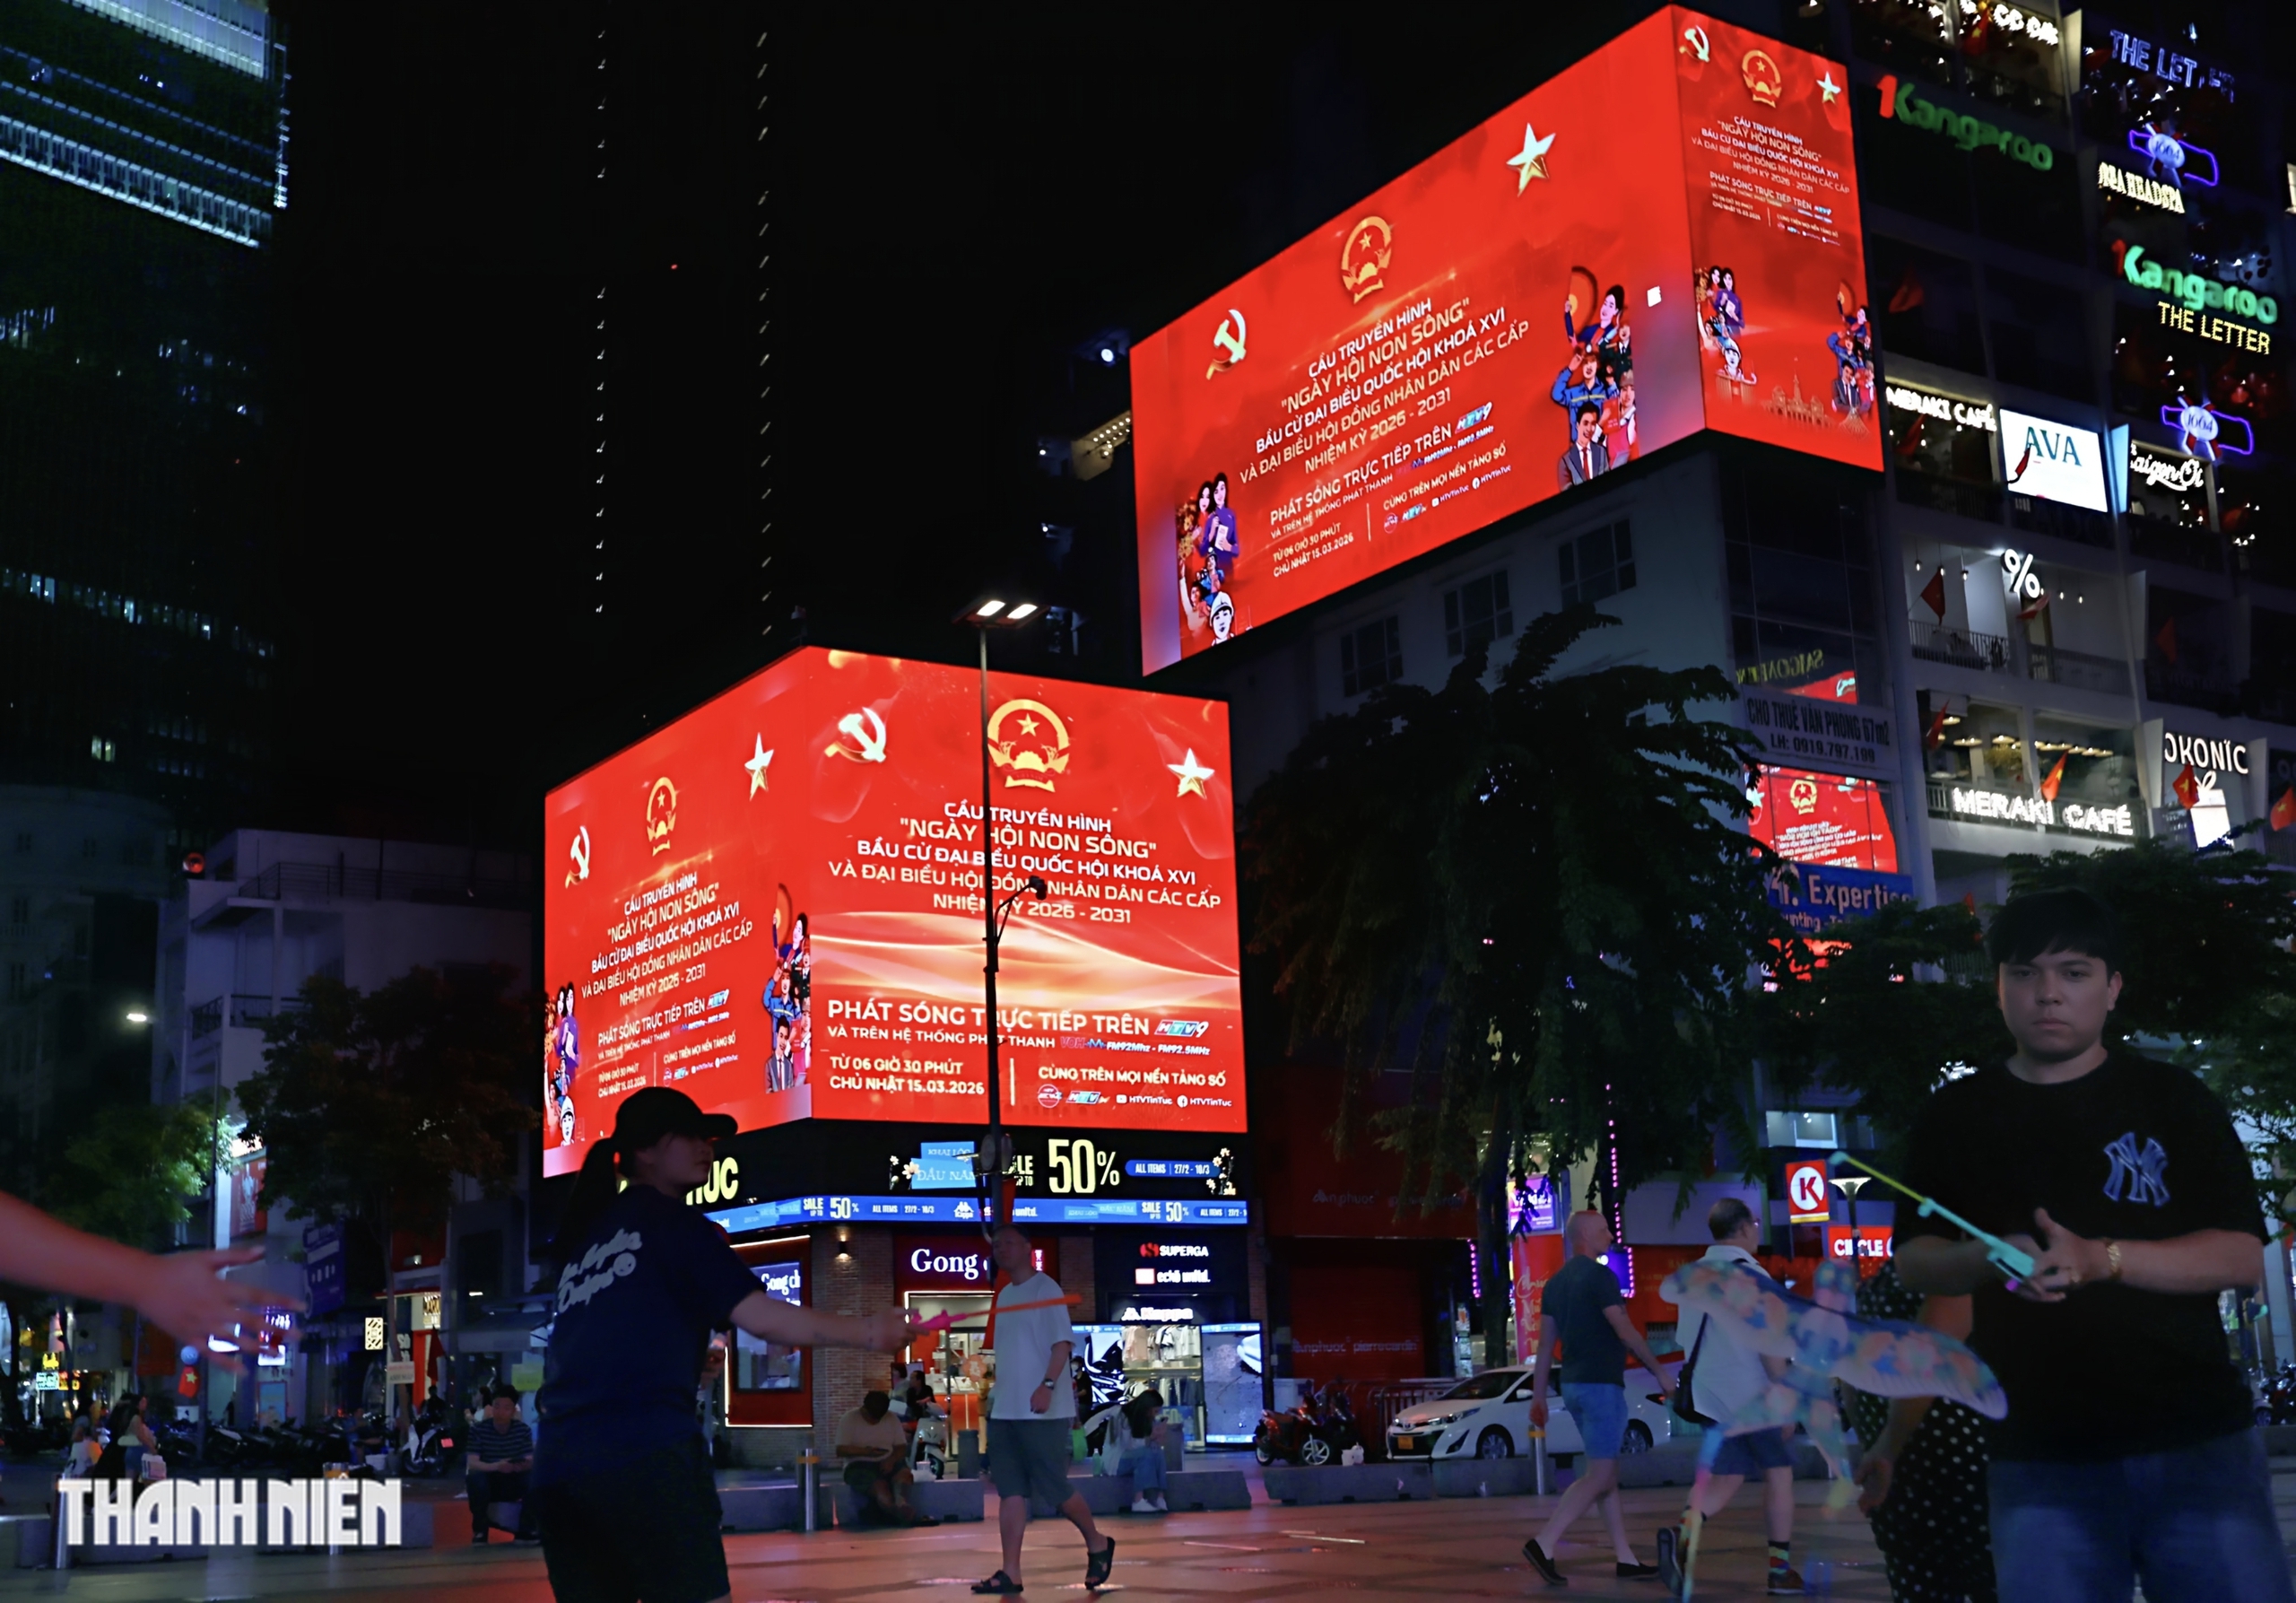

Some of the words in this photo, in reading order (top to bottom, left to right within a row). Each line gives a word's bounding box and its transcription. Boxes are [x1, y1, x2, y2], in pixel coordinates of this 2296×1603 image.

[2110, 29, 2151, 72] THE
[1309, 352, 1335, 377] CẦU
[1338, 319, 1394, 360] TRUYỀN
[1396, 298, 1431, 329] HÌNH
[2157, 301, 2194, 333] THE
[2200, 314, 2271, 355] LETTER
[1282, 374, 1331, 413] "NGÀY
[1336, 356, 1364, 386] HỘI
[1370, 333, 1407, 368] NON
[1412, 298, 1469, 345] SÔNG"
[1257, 428, 1282, 453] BẦU
[1285, 415, 1302, 437] CỬ
[1305, 404, 1326, 427] ĐẠI
[1330, 379, 1361, 414] BIỂU
[1364, 362, 1404, 395] QUỐC
[1406, 347, 1431, 372] HỘI
[1434, 320, 1476, 357] KHOÁ
[1480, 307, 1504, 333] XVI
[1240, 464, 1257, 483] VÀ
[1260, 452, 1281, 474] ĐẠI
[1284, 434, 1312, 461] BIỂU
[1317, 422, 1338, 444] HỘI
[1342, 399, 1380, 431] ĐỒNG
[1384, 376, 1424, 409] NHÂN
[1429, 357, 1459, 386] DÂN
[1464, 339, 1493, 366] CÁC
[1498, 320, 1528, 348] CẤP
[2187, 413, 2213, 433] 1664
[2027, 426, 2083, 467] AVA
[944, 798, 984, 820] CẦU
[989, 806, 1063, 828] TRUYỀN
[1067, 814, 1111, 832] HÌNH
[1952, 787, 2054, 825] MERAKI
[2064, 805, 2133, 835] CAFÉ
[900, 817, 977, 841] "NGÀY
[1030, 831, 1080, 851] NON
[1085, 834, 1156, 858] SÔNG"
[857, 837, 899, 858] BẦU
[904, 843, 932, 860] CỬ
[935, 848, 968, 867] ĐẠI
[972, 848, 1016, 868] BỂU
[1021, 854, 1074, 874] QUỐC
[1078, 860, 1109, 879] HỘI
[1113, 864, 1163, 882] KHOÁ
[1168, 869, 1196, 884] XVI
[829, 859, 857, 877] VÀ
[861, 864, 895, 884] ĐẠI
[900, 864, 945, 885] BIỂU
[951, 870, 984, 891] HỘI
[992, 871, 1037, 893] ĐỒN
[1048, 880, 1100, 898] NHÂN
[1105, 884, 1144, 902] DÂN
[1147, 887, 1182, 906] CÁC
[1185, 884, 1221, 909] CẤP
[1027, 901, 1075, 919] 2026
[1090, 906, 1131, 923] 2031
[827, 1024, 848, 1038] VÀ
[851, 1025, 889, 1040] TRÊN
[892, 1027, 911, 1043] HỆ
[915, 1028, 965, 1043] THỐNG
[969, 1033, 1005, 1045] PHT
[1008, 1035, 1056, 1048] THANH
[828, 998, 891, 1021] PHÁT
[899, 1001, 966, 1025] SÓNG
[1040, 1006, 1087, 1032] TIẾP
[1094, 1011, 1149, 1035] TRÊN
[1154, 1019, 1209, 1037] HTV9
[830, 1055, 850, 1069] TỪ
[852, 1058, 872, 1070] 06
[874, 1056, 901, 1072] GIỜ
[904, 1059, 922, 1073] 30
[924, 1059, 963, 1075] PHÚT
[830, 1073, 862, 1090] CHỦ
[865, 1076, 906, 1093] NHẬT
[907, 1078, 985, 1095] 15.03.2026
[1038, 1063, 1079, 1081] CÙNG
[1082, 1066, 1114, 1082] TRÊN
[1117, 1070, 1141, 1085] MỌI
[1171, 1069, 1205, 1086] TẢNG
[1208, 1070, 1226, 1087] SỐ
[1135, 1162, 1148, 1174] ALL
[1149, 1162, 1166, 1175] ITEMS
[1142, 1202, 1161, 1214] SALE
[910, 1249, 978, 1281] Gong
[1159, 1245, 1209, 1257] SUPERGA
